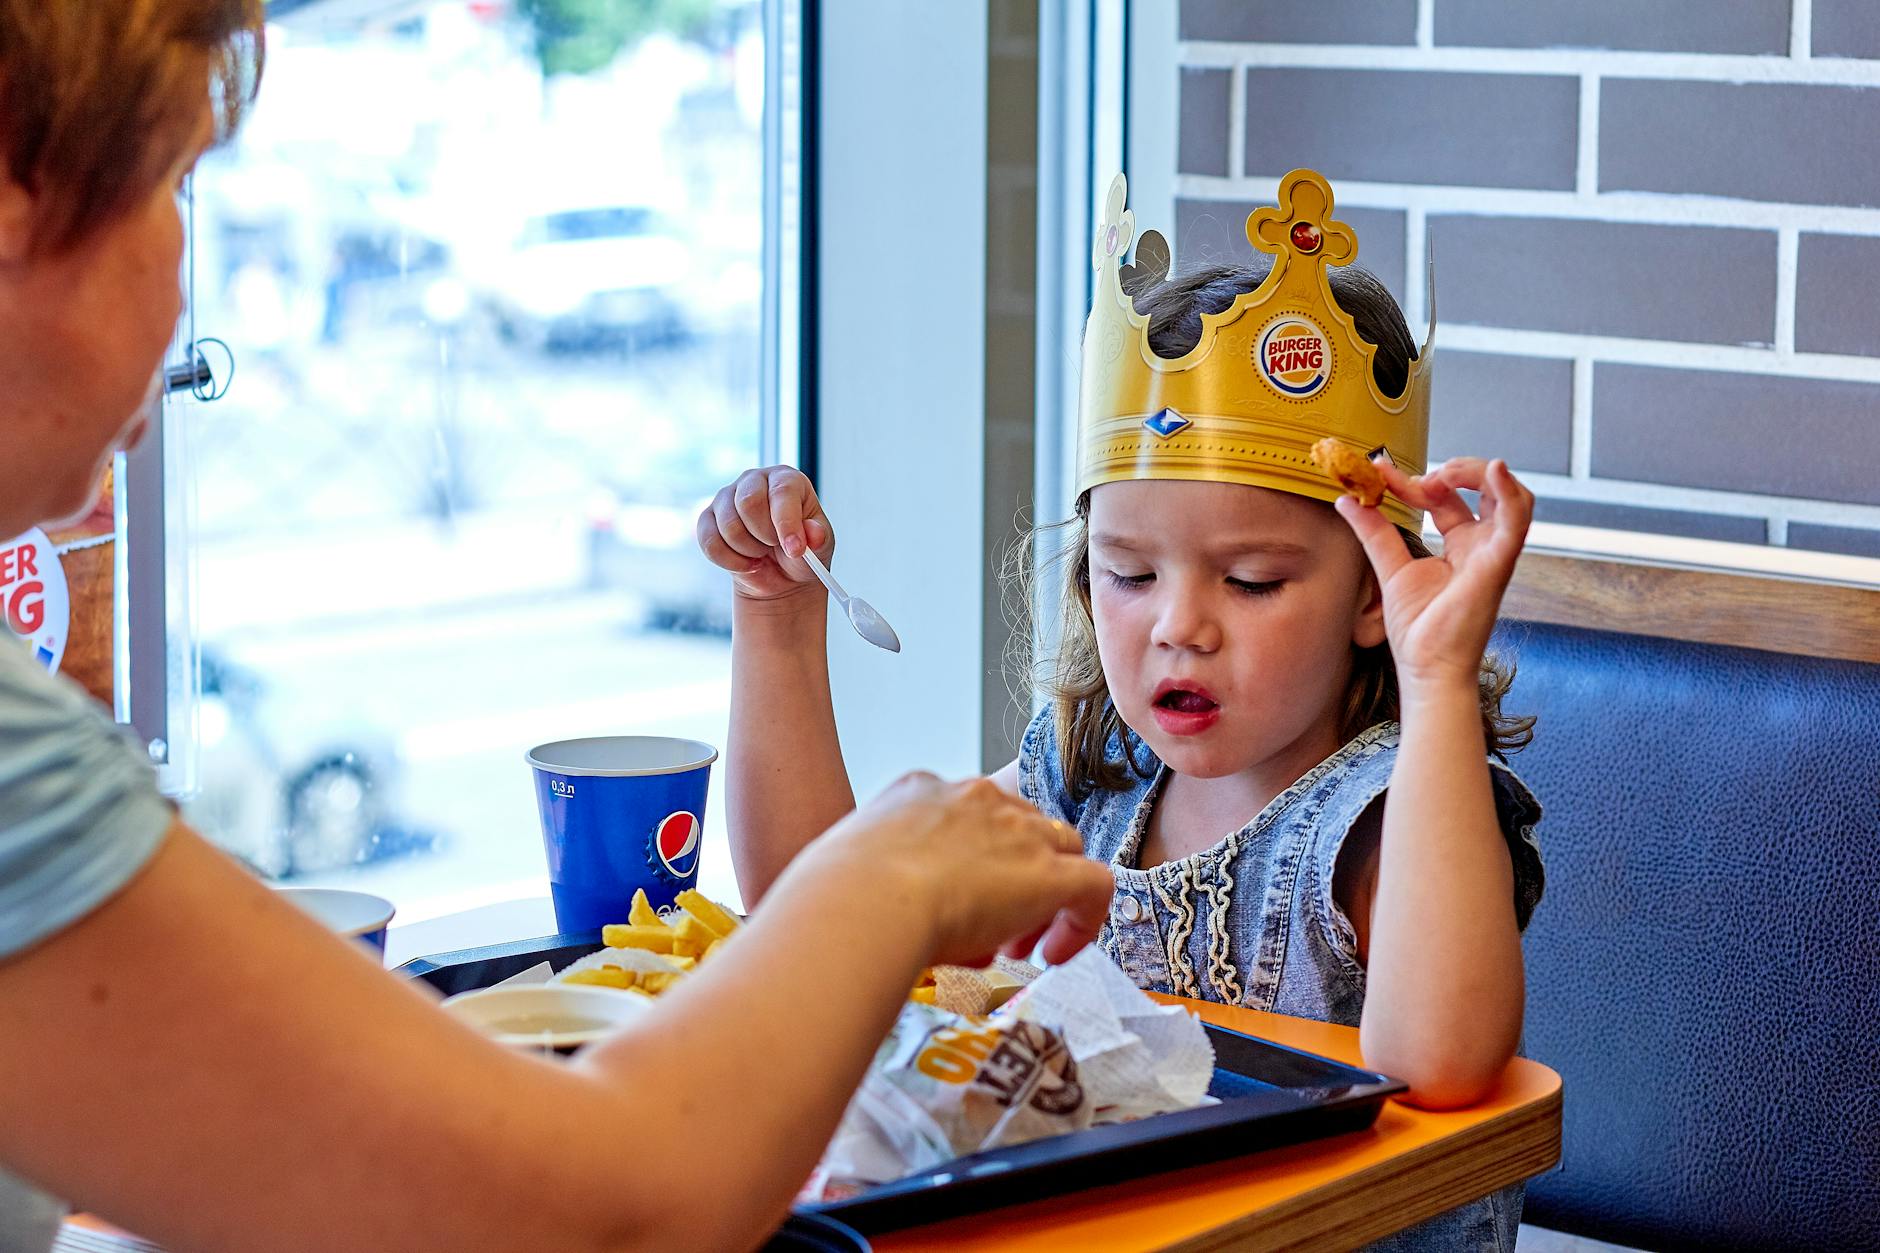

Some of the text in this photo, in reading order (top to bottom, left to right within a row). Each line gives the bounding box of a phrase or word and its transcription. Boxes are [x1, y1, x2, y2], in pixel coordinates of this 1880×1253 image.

[1268, 338, 1322, 356] BURGER
[1269, 350, 1323, 375] KING
[0, 581, 44, 635] G
